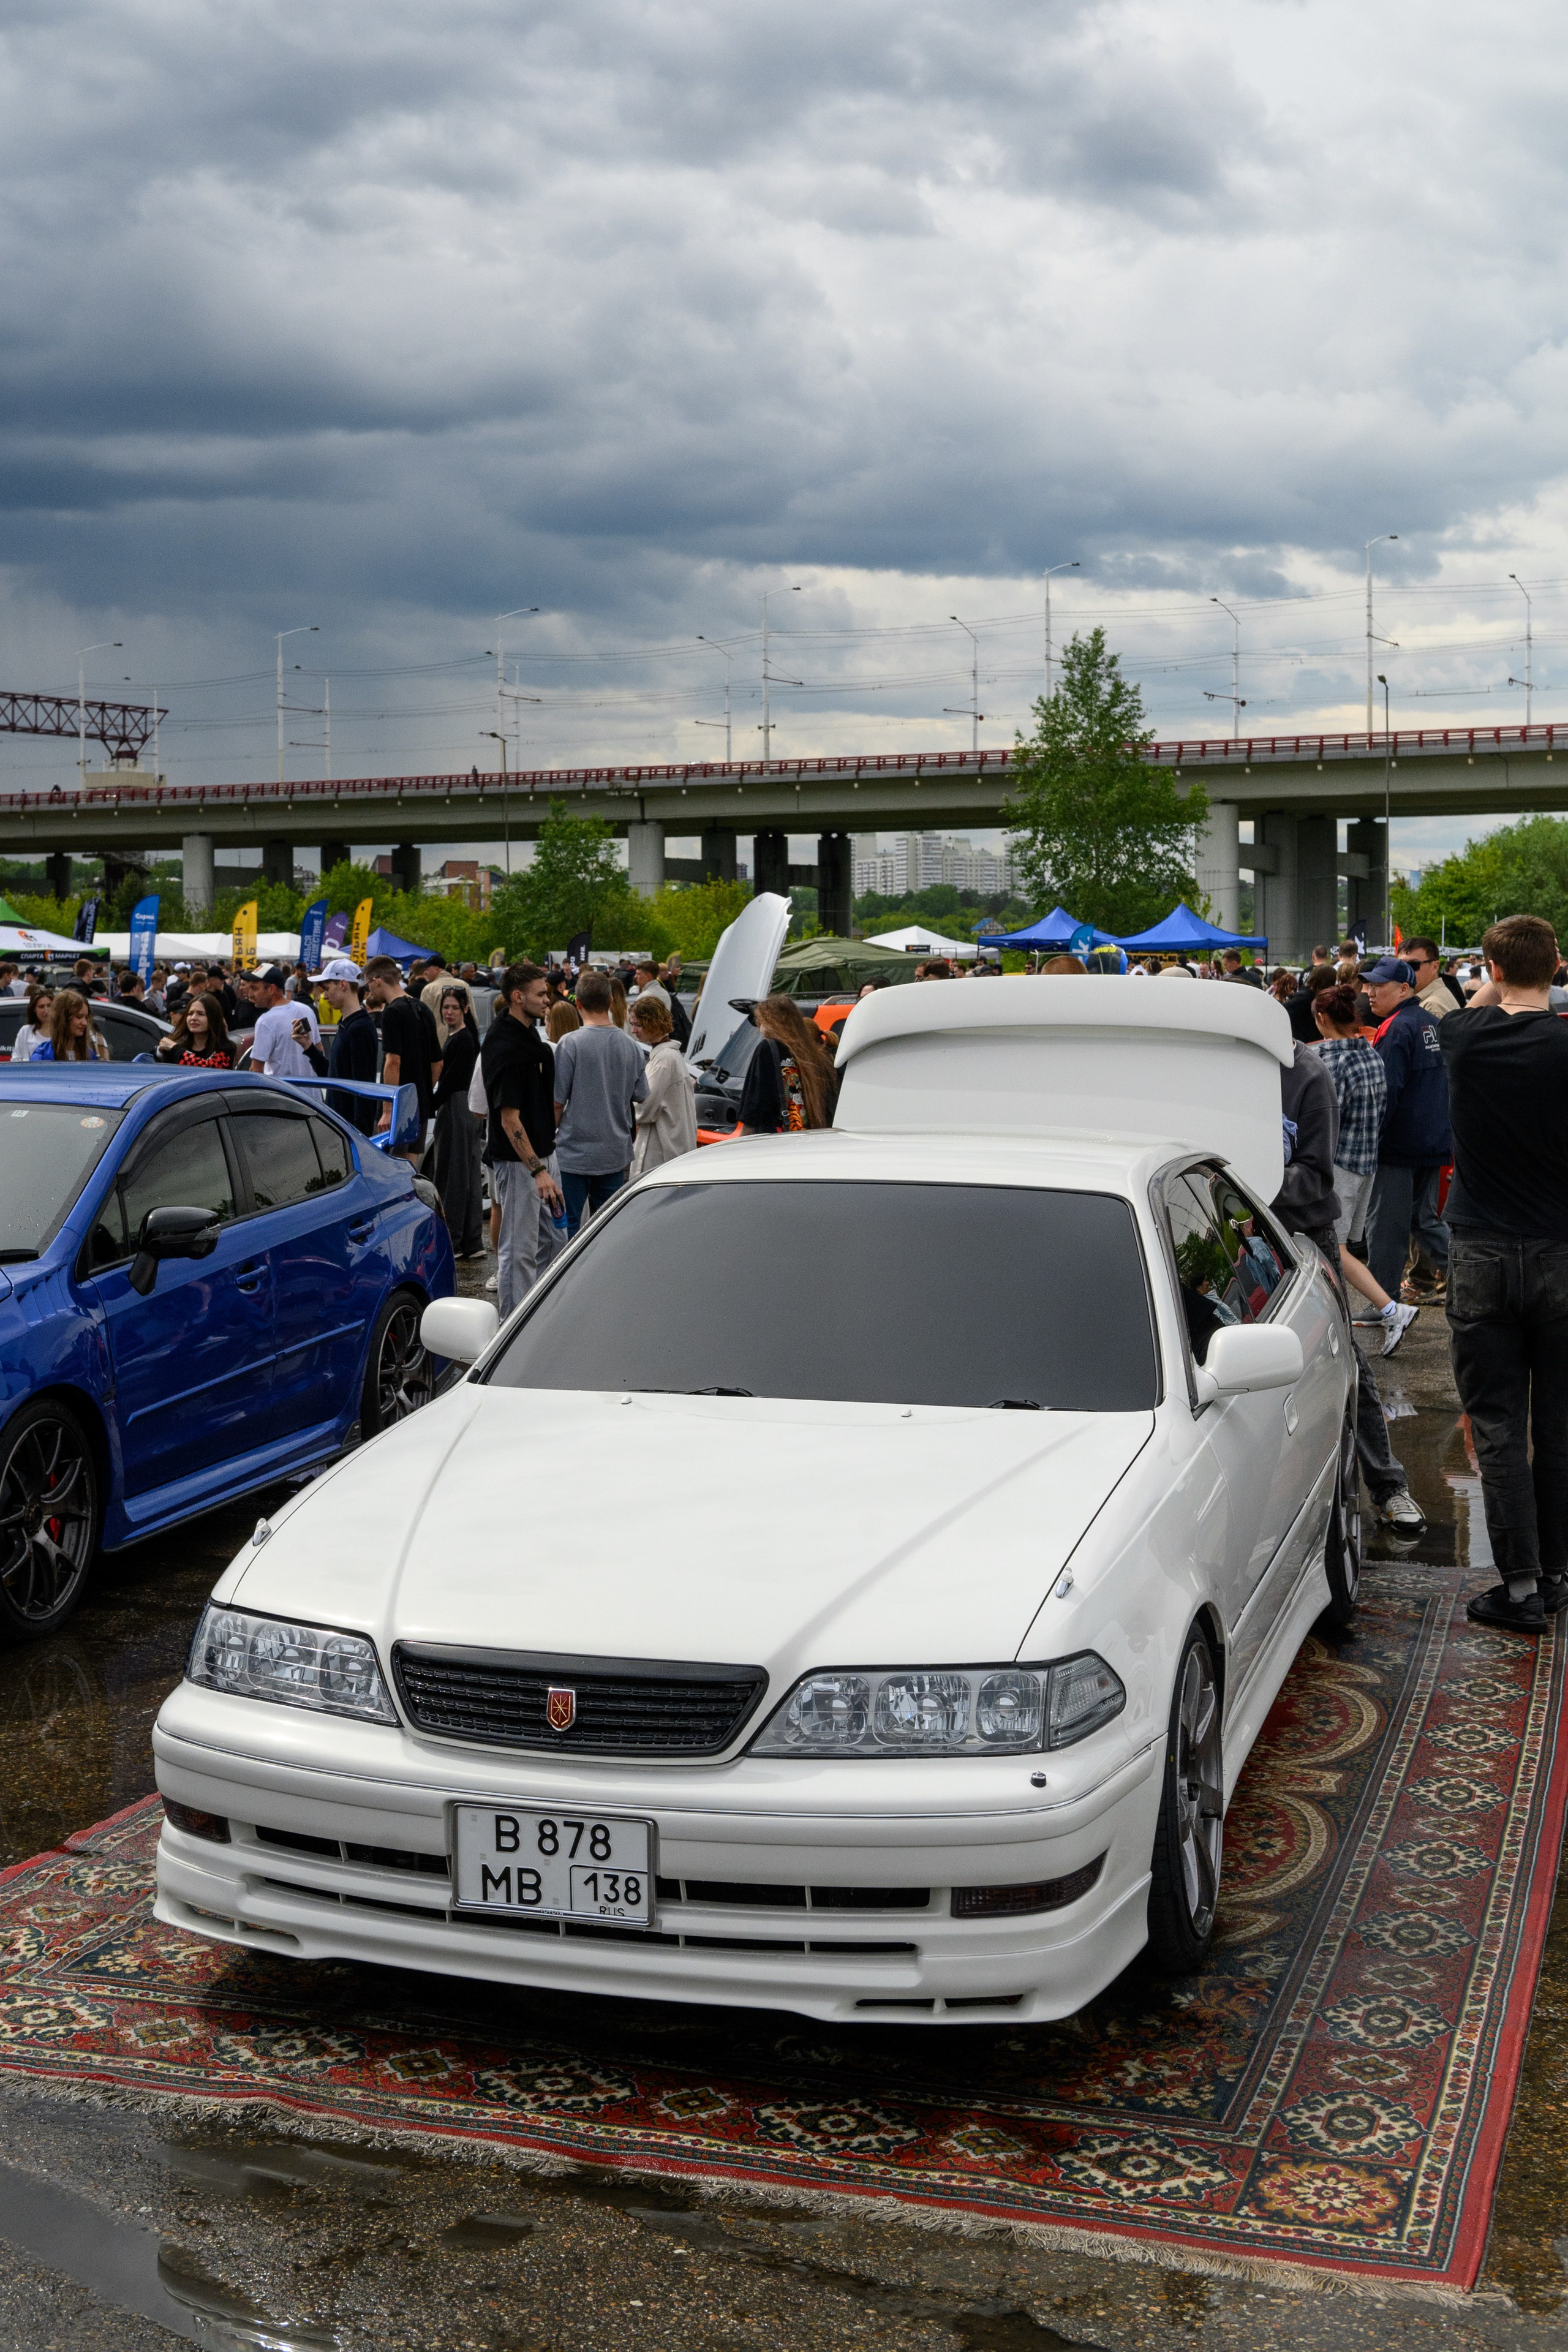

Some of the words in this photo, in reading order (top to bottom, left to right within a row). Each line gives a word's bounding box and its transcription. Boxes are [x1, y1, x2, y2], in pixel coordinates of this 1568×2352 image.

[495, 1814, 520, 1853] B
[537, 1819, 612, 1861] 878
[481, 1863, 542, 1905] MB
[583, 1872, 641, 1905] 138
[599, 1905, 625, 1917] RUS
